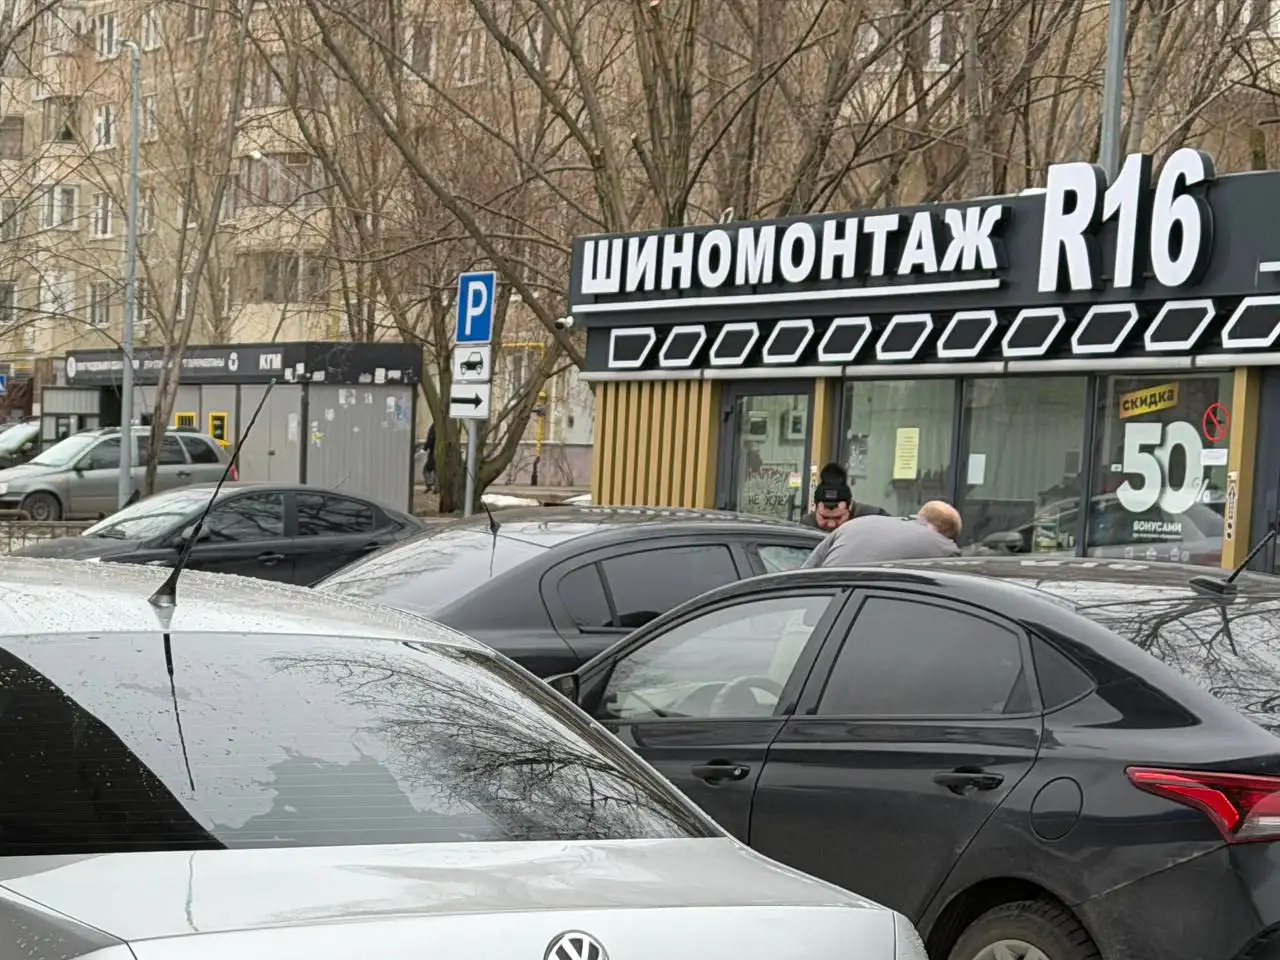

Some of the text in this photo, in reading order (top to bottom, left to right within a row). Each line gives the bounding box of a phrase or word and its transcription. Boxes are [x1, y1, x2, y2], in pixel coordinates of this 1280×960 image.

[581, 205, 1002, 294] ШИНОМОНТАЖ
[1038, 147, 1208, 293] R16
[465, 280, 487, 336] P
[1132, 520, 1182, 533] БОНУСАМИ
